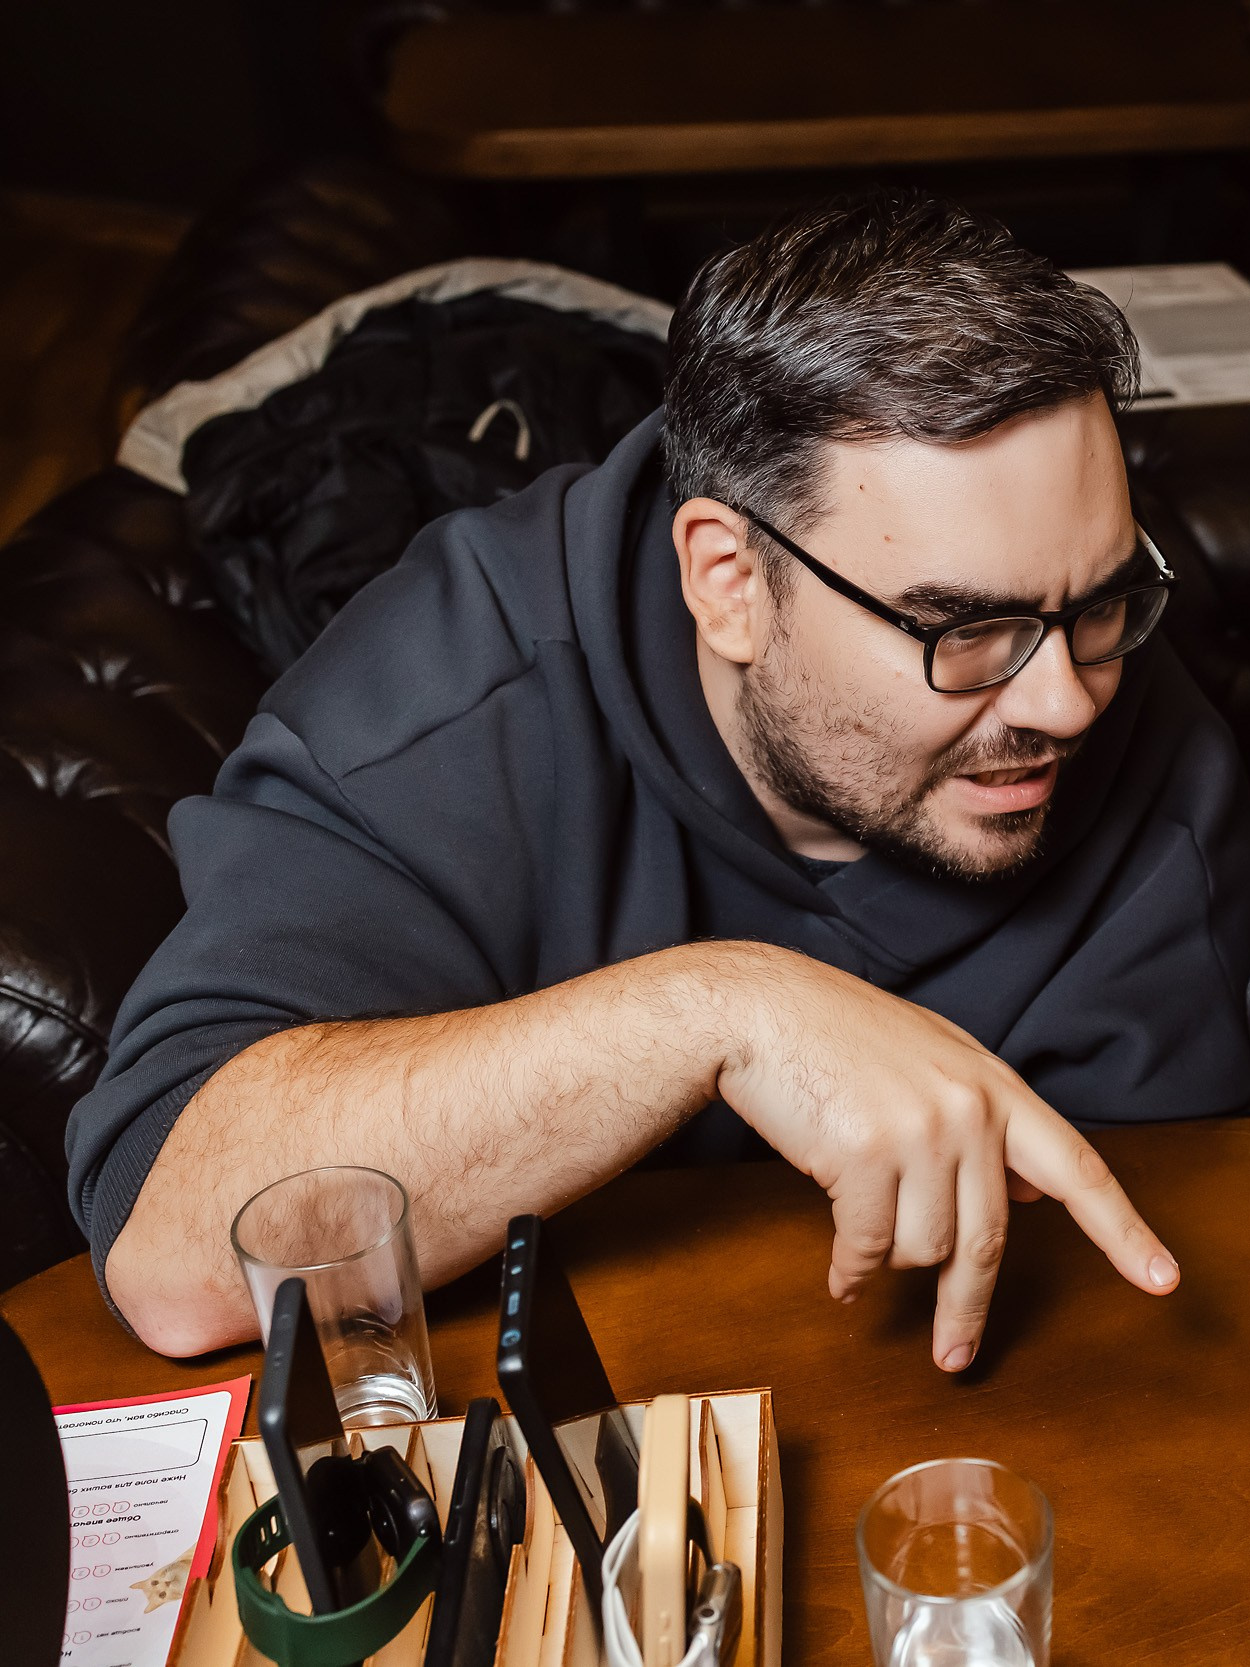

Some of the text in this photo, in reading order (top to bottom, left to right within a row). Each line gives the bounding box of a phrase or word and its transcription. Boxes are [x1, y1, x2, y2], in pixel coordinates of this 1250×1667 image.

[147, 1408, 189, 1418] Спасибо
[134, 1478, 158, 1486] поле
[161, 1474, 186, 1483] Ниже
[80, 1485, 112, 1493] ваших
[133, 1500, 168, 1508] печально
[106, 1515, 140, 1524] Общее
[124, 1529, 180, 1540] отвратительно
